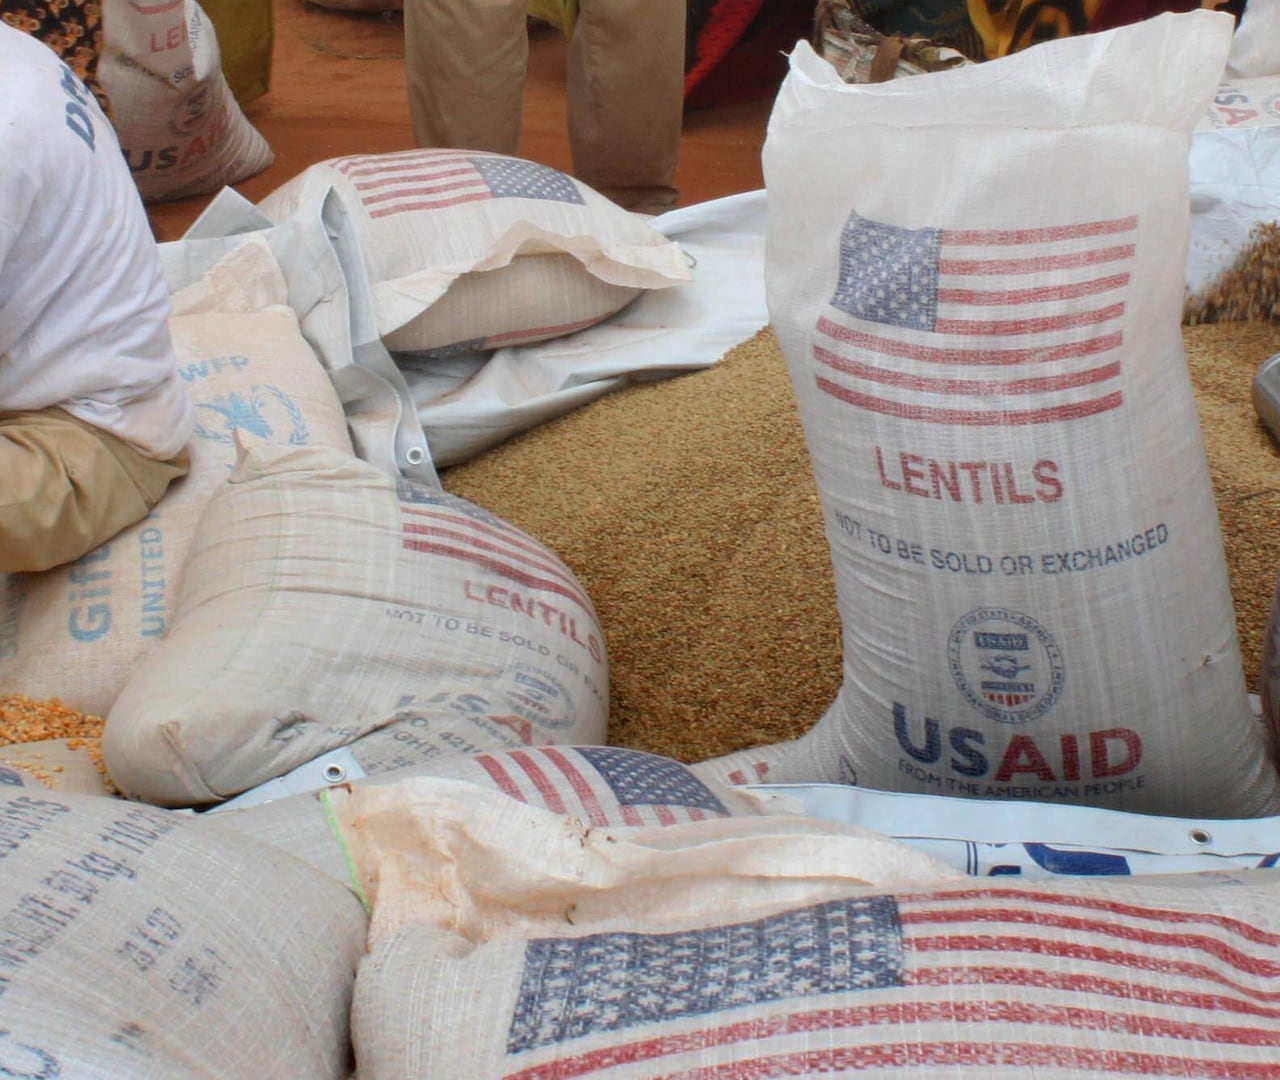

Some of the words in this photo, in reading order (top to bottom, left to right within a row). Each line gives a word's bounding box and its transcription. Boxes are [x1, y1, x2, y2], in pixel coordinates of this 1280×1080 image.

[178, 354, 249, 383] WFP
[874, 445, 1065, 505] LENTILS
[868, 528, 892, 554] TO
[896, 539, 925, 565] BE
[931, 548, 993, 576] SOLD
[999, 554, 1033, 577] OR
[1040, 521, 1170, 576] EXCHANGED
[139, 527, 166, 638] UNITED
[384, 607, 426, 626] NOT
[433, 613, 461, 632] TO
[465, 622, 494, 638] BE
[498, 631, 551, 657] SOLD
[463, 579, 602, 665] LENTILS
[892, 700, 1144, 783] USAID
[898, 758, 942, 789] FROM
[947, 777, 980, 797] THE
[983, 783, 1080, 800] AMERICAN
[1083, 773, 1147, 798] PEOPLE
